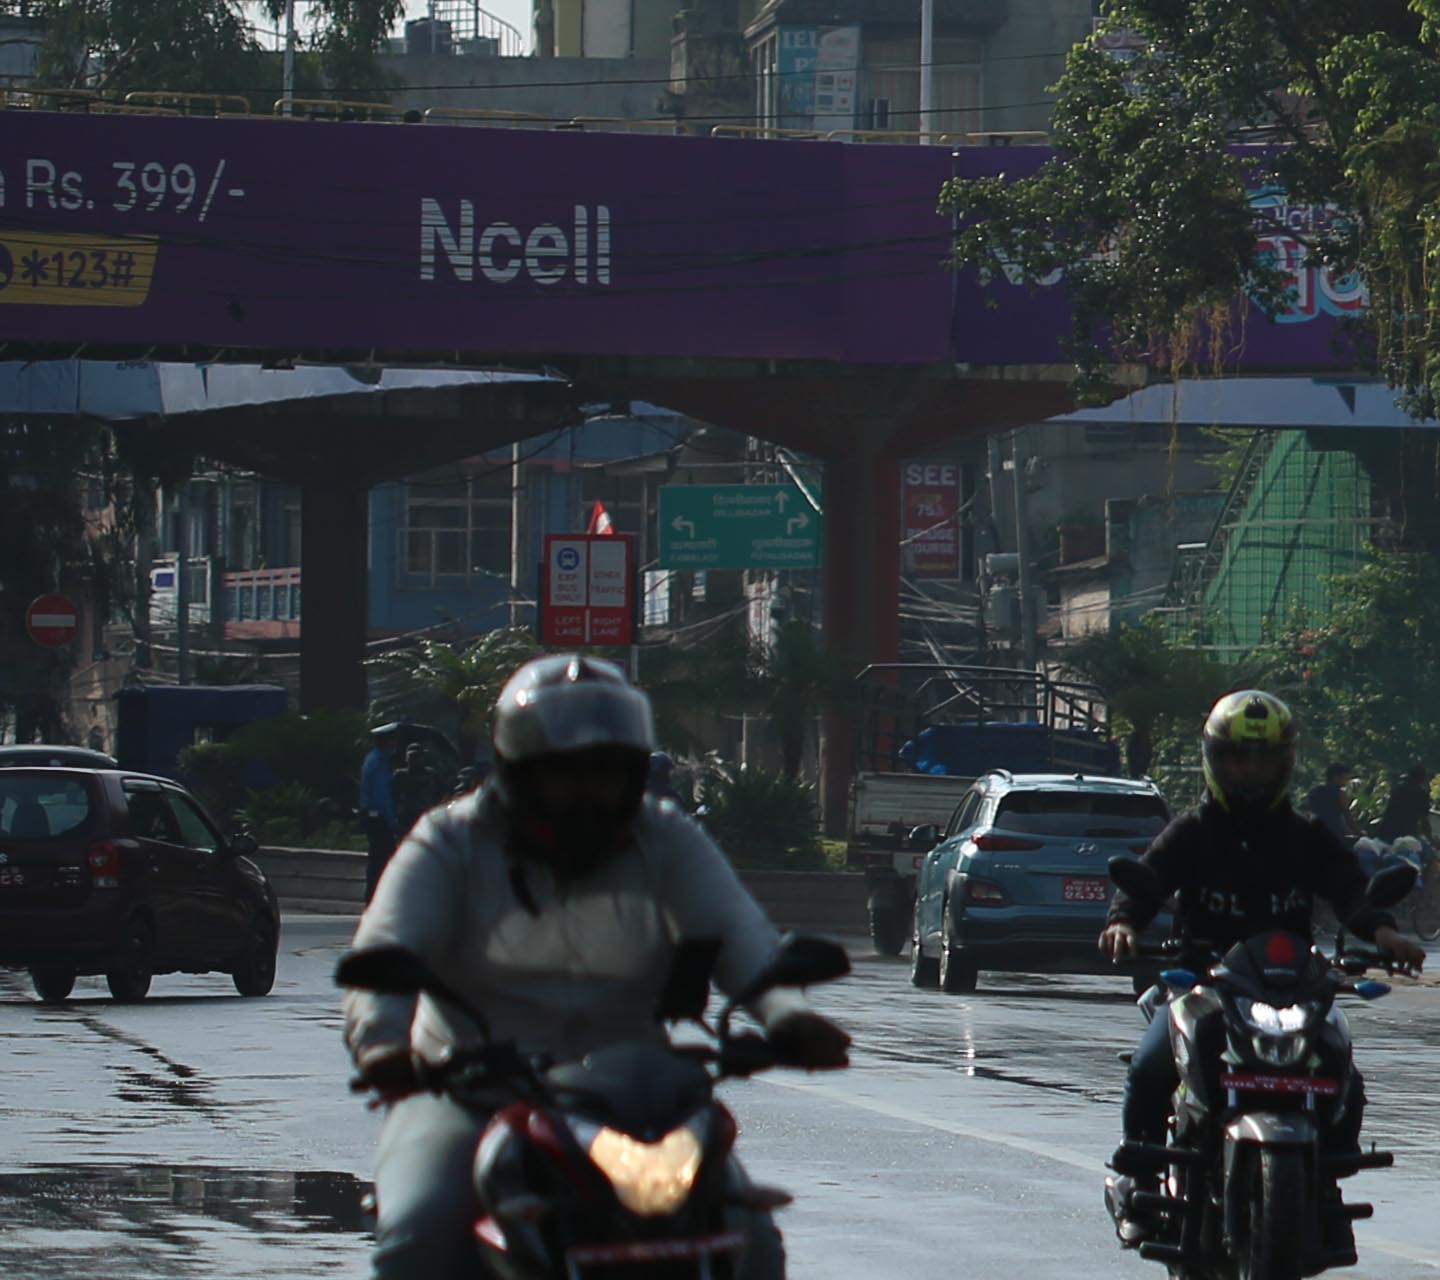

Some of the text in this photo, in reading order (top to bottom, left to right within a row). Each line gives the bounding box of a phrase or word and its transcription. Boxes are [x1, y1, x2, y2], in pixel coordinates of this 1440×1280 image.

[24, 158, 246, 223] Rs. 399/-
[420, 197, 611, 286] Ncell
[906, 463, 957, 487] SEE
[555, 616, 581, 625] LEFT
[593, 617, 622, 625] RIGHT
[555, 628, 583, 636] LANE
[593, 628, 621, 637] LANE
